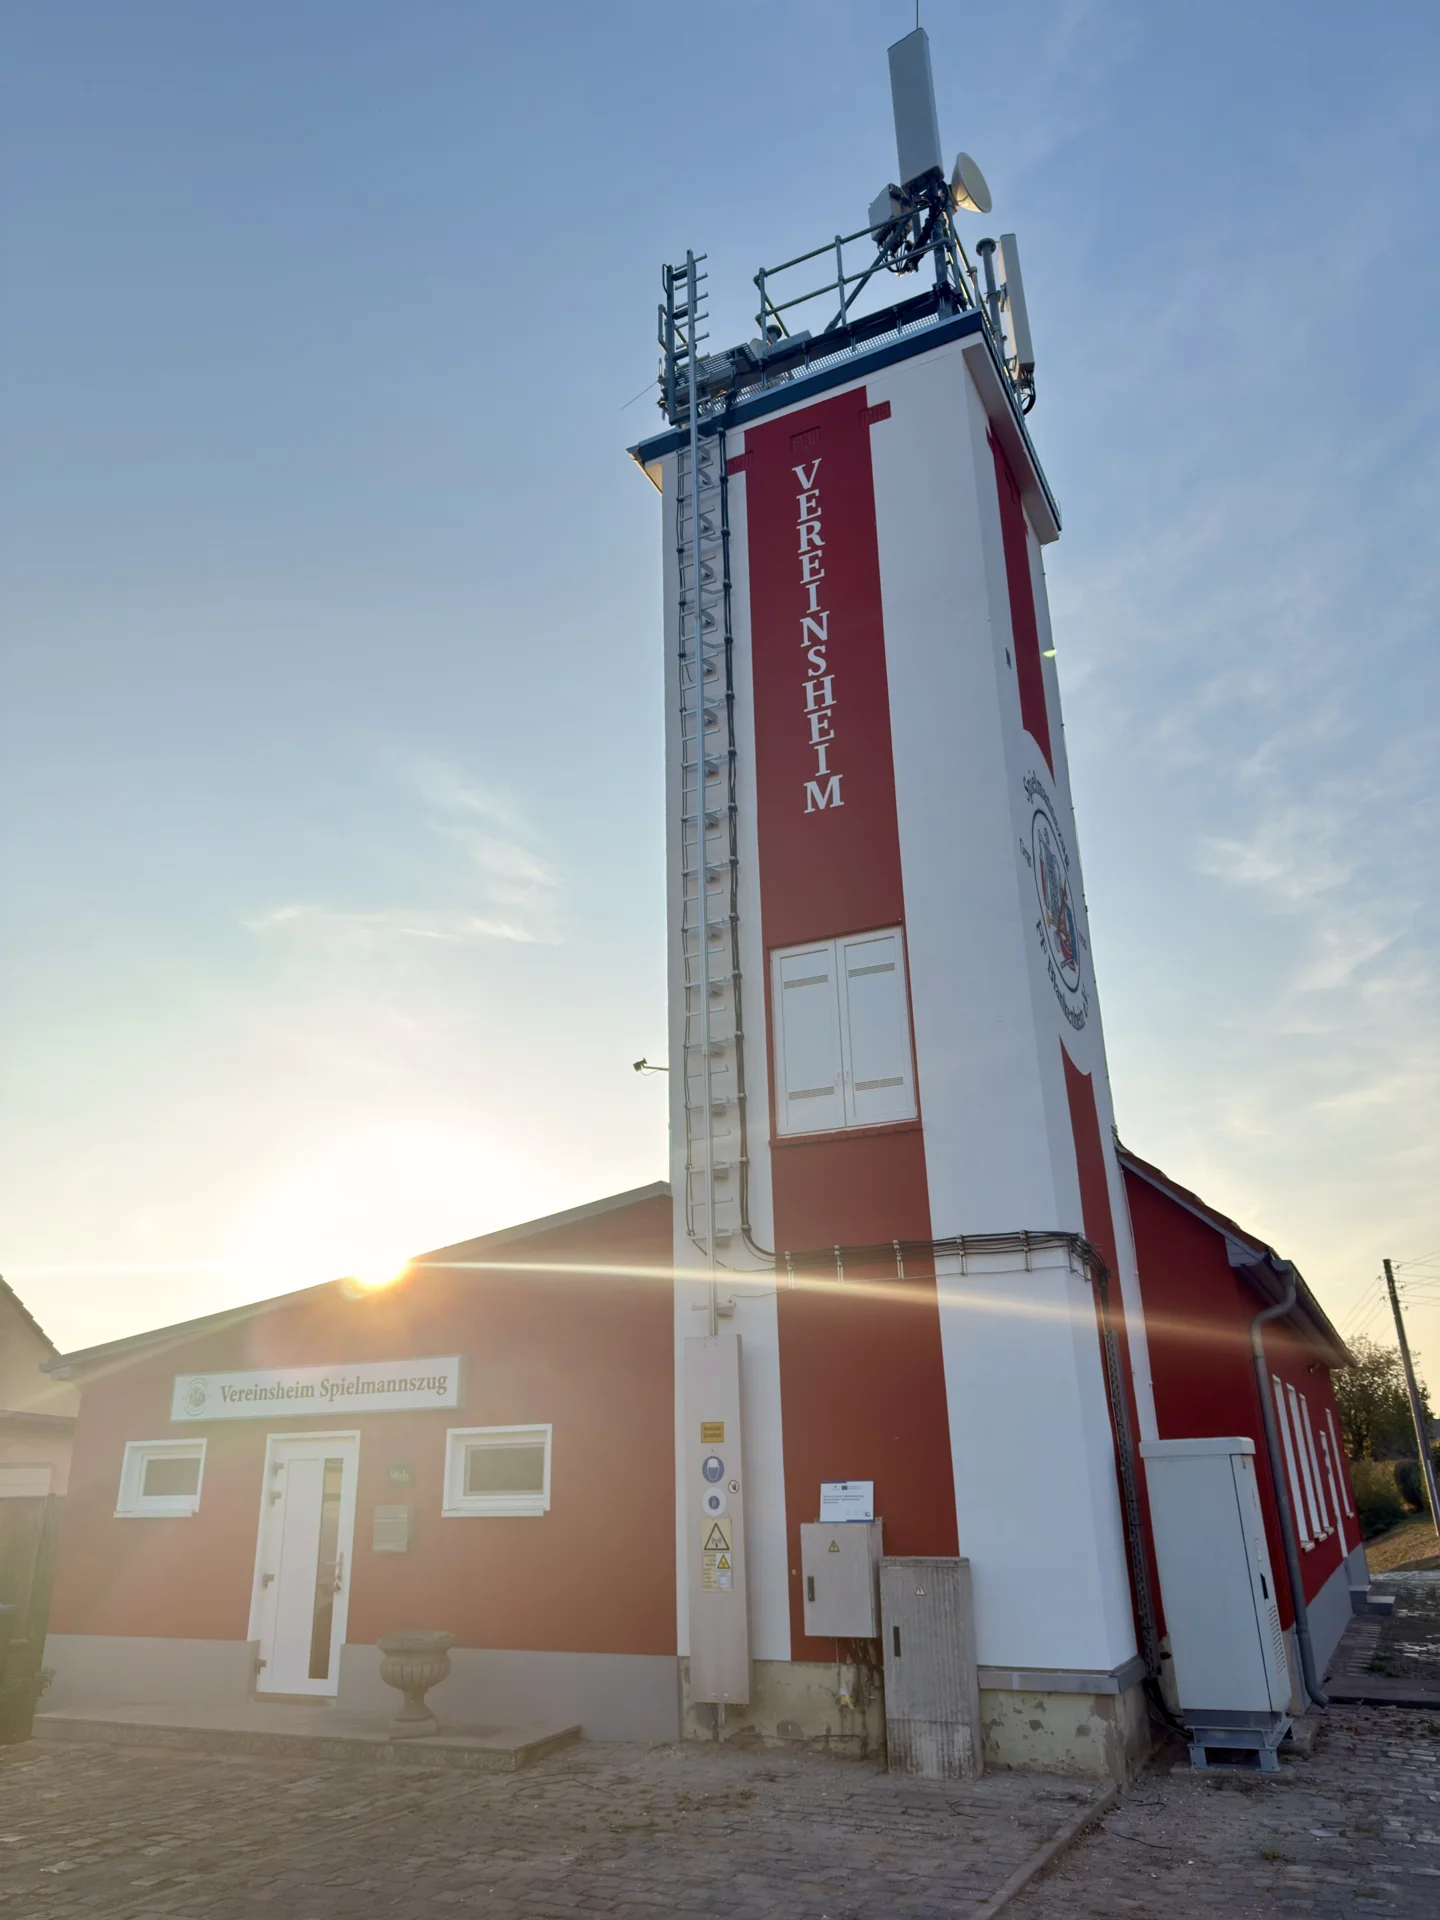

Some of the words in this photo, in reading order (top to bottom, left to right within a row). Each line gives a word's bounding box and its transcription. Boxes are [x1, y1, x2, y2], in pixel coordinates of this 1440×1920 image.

[792, 458, 845, 814] VEREINSHEIM
[220, 1380, 315, 1404] Vereinsheim
[319, 1375, 448, 1402] Spielmannszug
